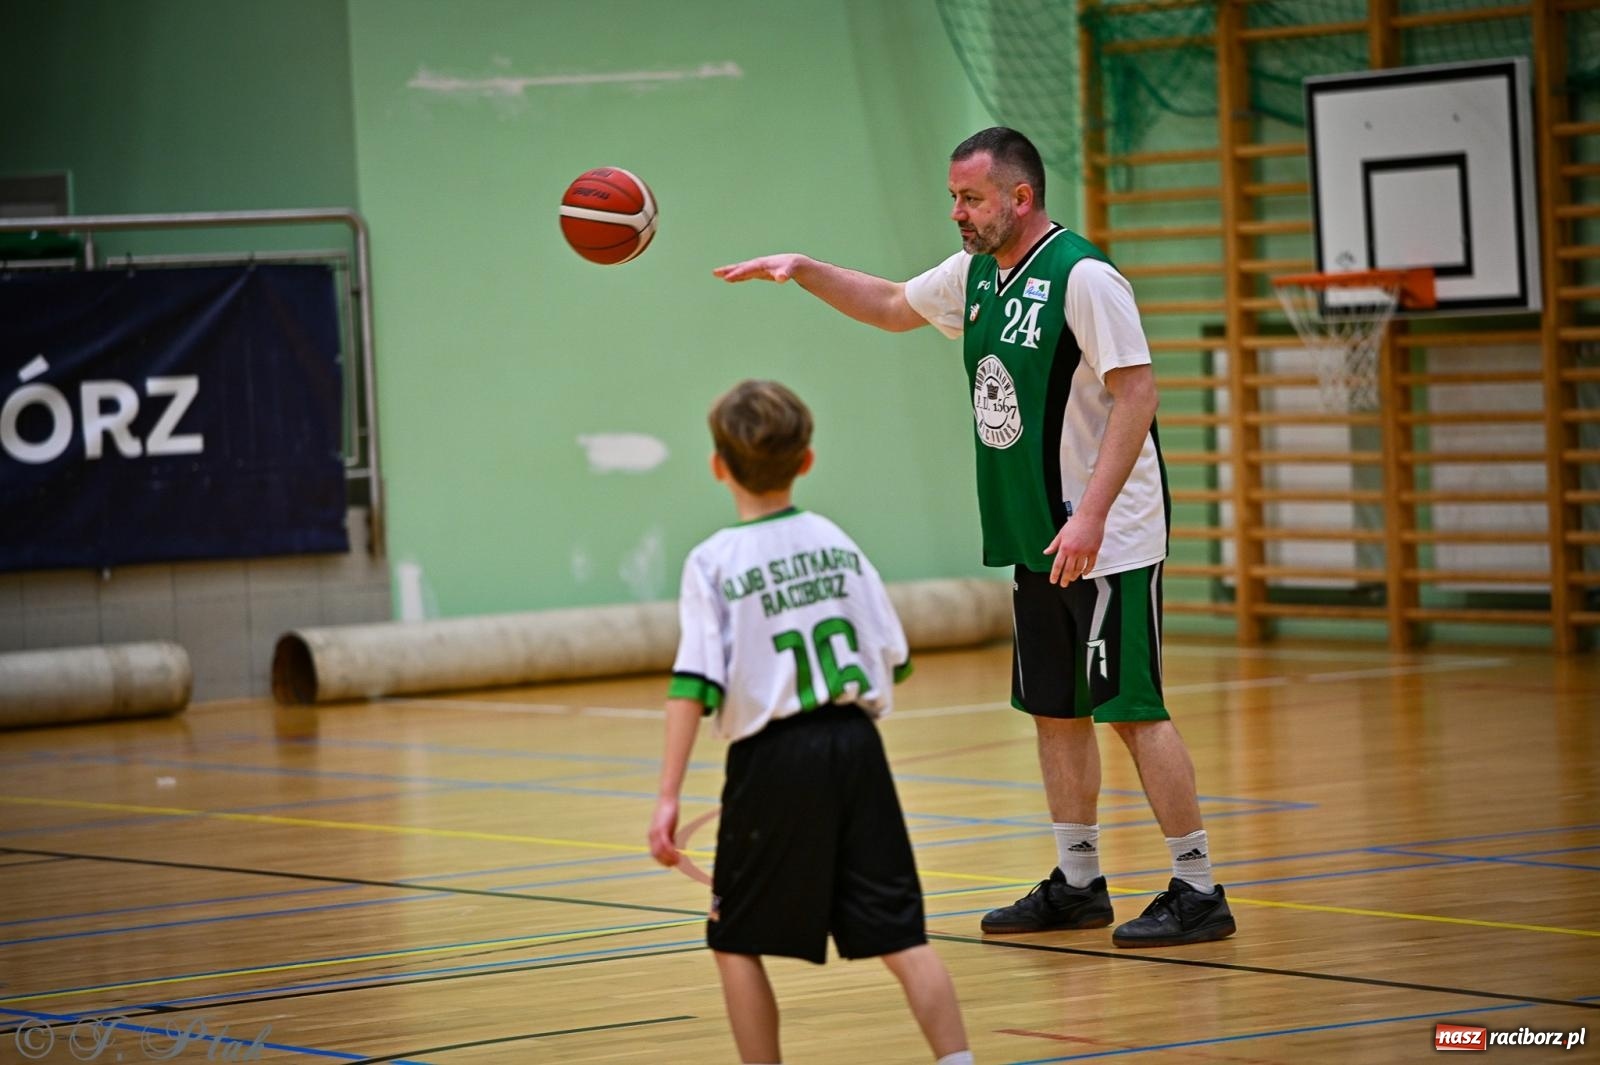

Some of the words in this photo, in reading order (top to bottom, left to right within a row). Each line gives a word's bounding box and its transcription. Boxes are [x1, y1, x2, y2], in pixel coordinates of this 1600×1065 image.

[1000, 297, 1046, 349] 24
[0, 354, 204, 464] ÓRZ
[993, 396, 1017, 420] 1567
[772, 617, 873, 711] 16
